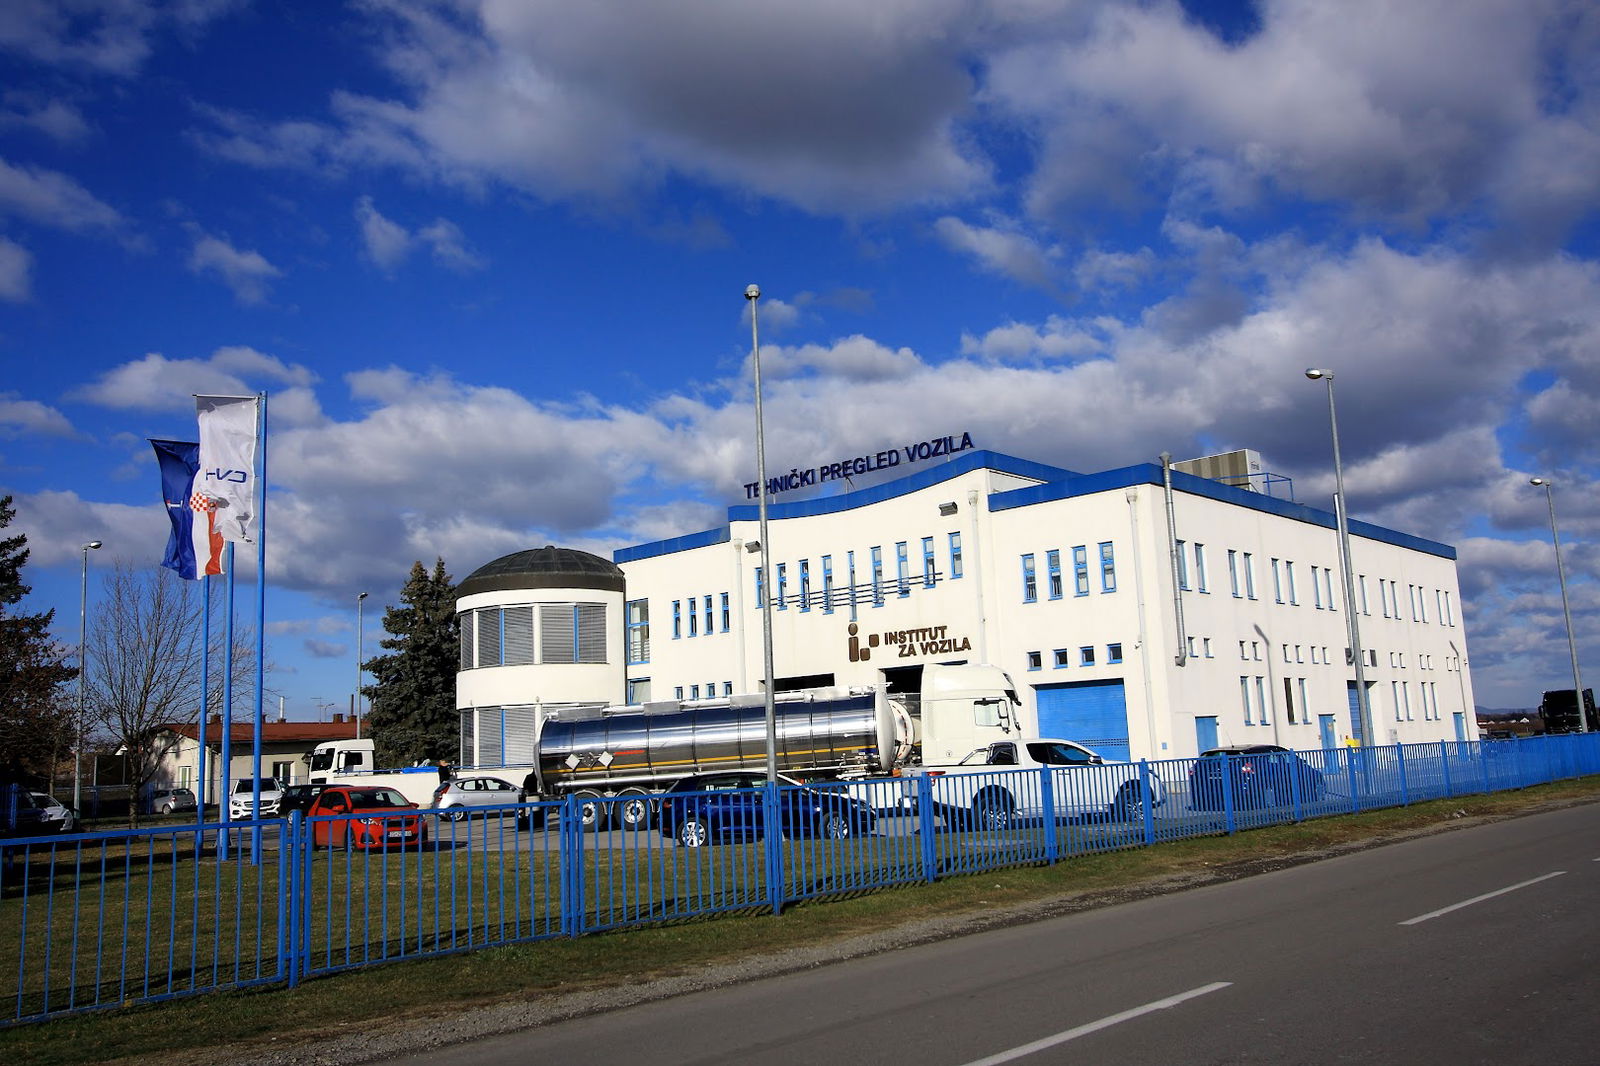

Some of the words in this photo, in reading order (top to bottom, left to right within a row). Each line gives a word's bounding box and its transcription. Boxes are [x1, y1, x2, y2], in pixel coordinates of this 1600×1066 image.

[743, 468, 816, 499] TEHNIČKI
[820, 449, 900, 482] PREGLED
[905, 432, 975, 463] VOZILA
[884, 625, 948, 646] INSTITUT
[898, 643, 917, 658] ZA
[920, 637, 972, 656] VOZILA
